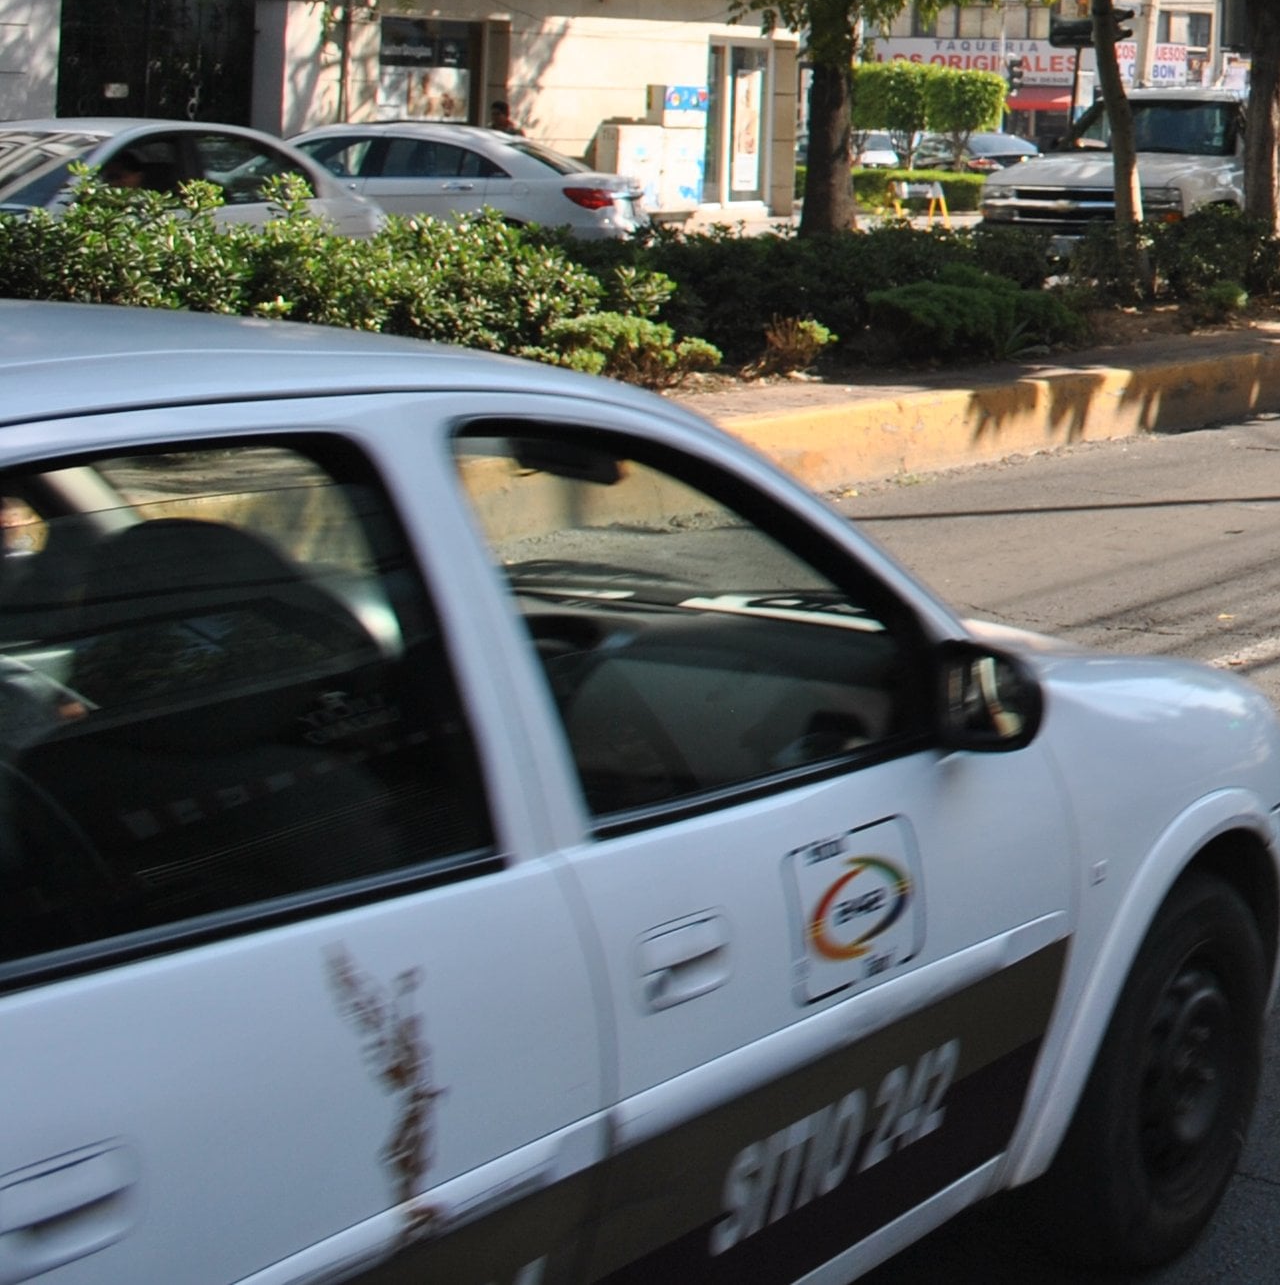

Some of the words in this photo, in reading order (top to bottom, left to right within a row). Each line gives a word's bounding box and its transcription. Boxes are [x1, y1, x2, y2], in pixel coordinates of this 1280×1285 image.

[934, 40, 1039, 53] TAQUERIA
[1155, 45, 1187, 62] UESOS
[930, 54, 1077, 72] ORIGIALES
[709, 1087, 868, 1257] SITIO
[856, 1037, 961, 1174] 242
